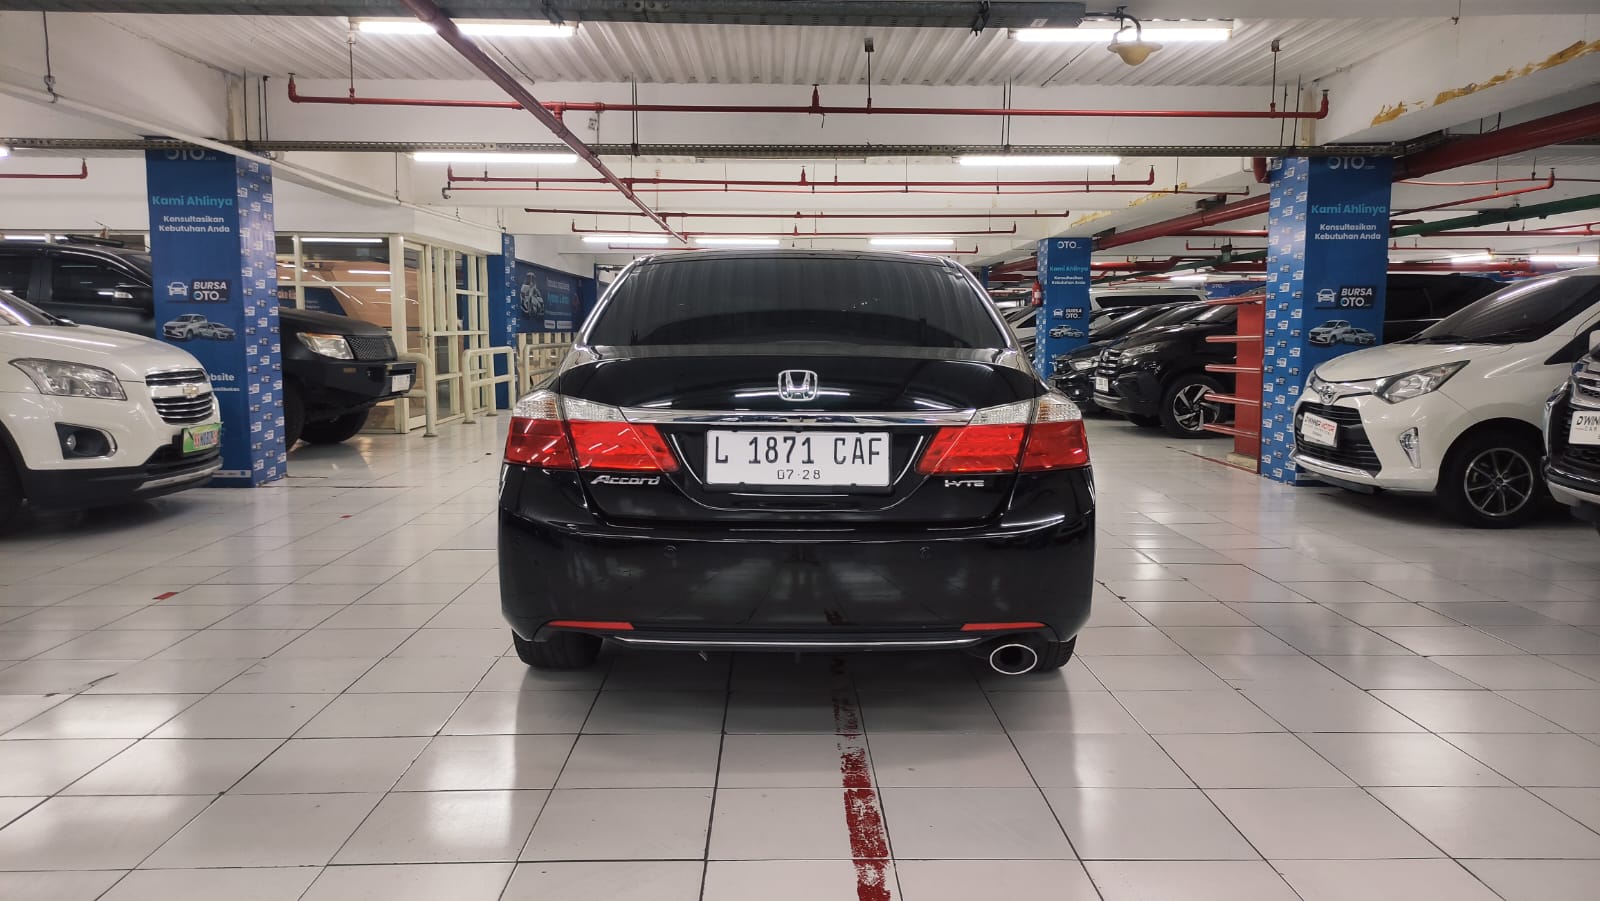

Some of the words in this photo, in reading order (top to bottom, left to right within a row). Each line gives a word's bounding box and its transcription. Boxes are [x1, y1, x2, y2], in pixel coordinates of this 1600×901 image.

[151, 195, 185, 205] Kami
[187, 195, 233, 208] Ahlinya
[1311, 203, 1341, 214] Kami
[1343, 203, 1386, 216] Ahlinya
[163, 215, 225, 223] Konsultasikan
[159, 225, 206, 233] Kebutuhan
[207, 225, 230, 233] Anda
[1320, 223, 1377, 231] Konsultasikan
[193, 281, 227, 290] BURSA
[1341, 287, 1373, 296] BURSA
[715, 436, 729, 464] L
[748, 436, 815, 464] 1871
[833, 437, 882, 465] CAF
[590, 475, 661, 485] Accord
